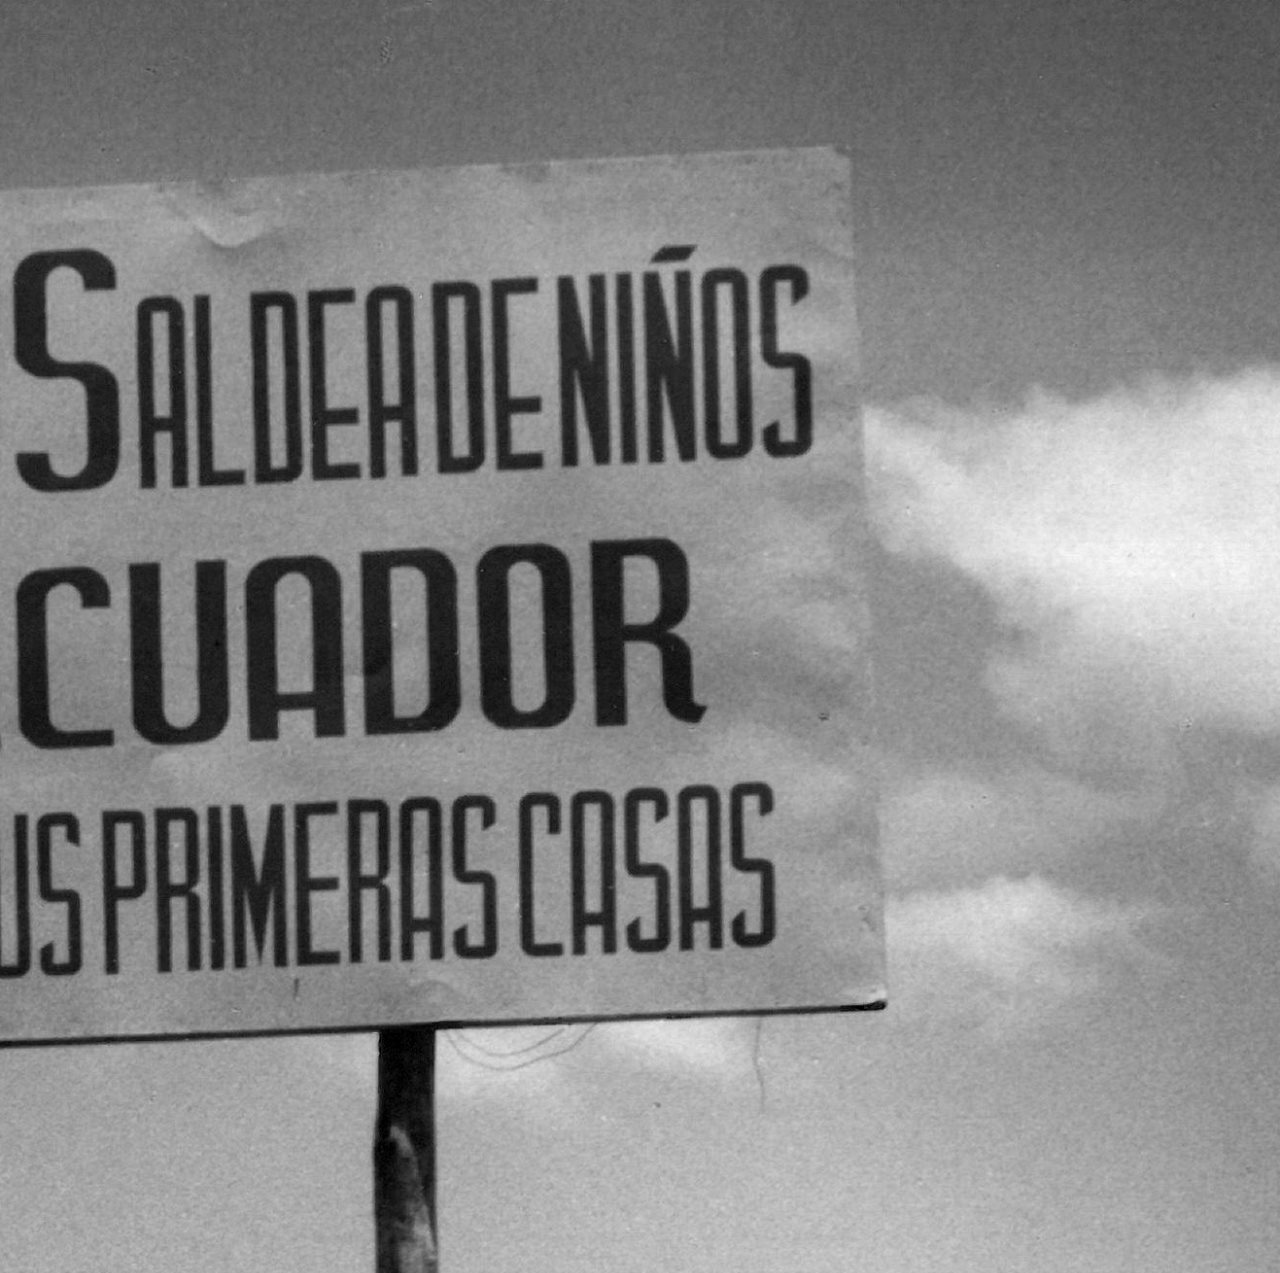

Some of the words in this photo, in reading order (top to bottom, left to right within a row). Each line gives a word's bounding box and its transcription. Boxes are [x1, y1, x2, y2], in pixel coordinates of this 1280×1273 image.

[136, 285, 419, 490] ALDEA
[431, 277, 544, 475] DE
[557, 244, 813, 468] NIÑOS
[101, 794, 498, 976] PRIMERAS
[518, 782, 776, 958] CASAS
